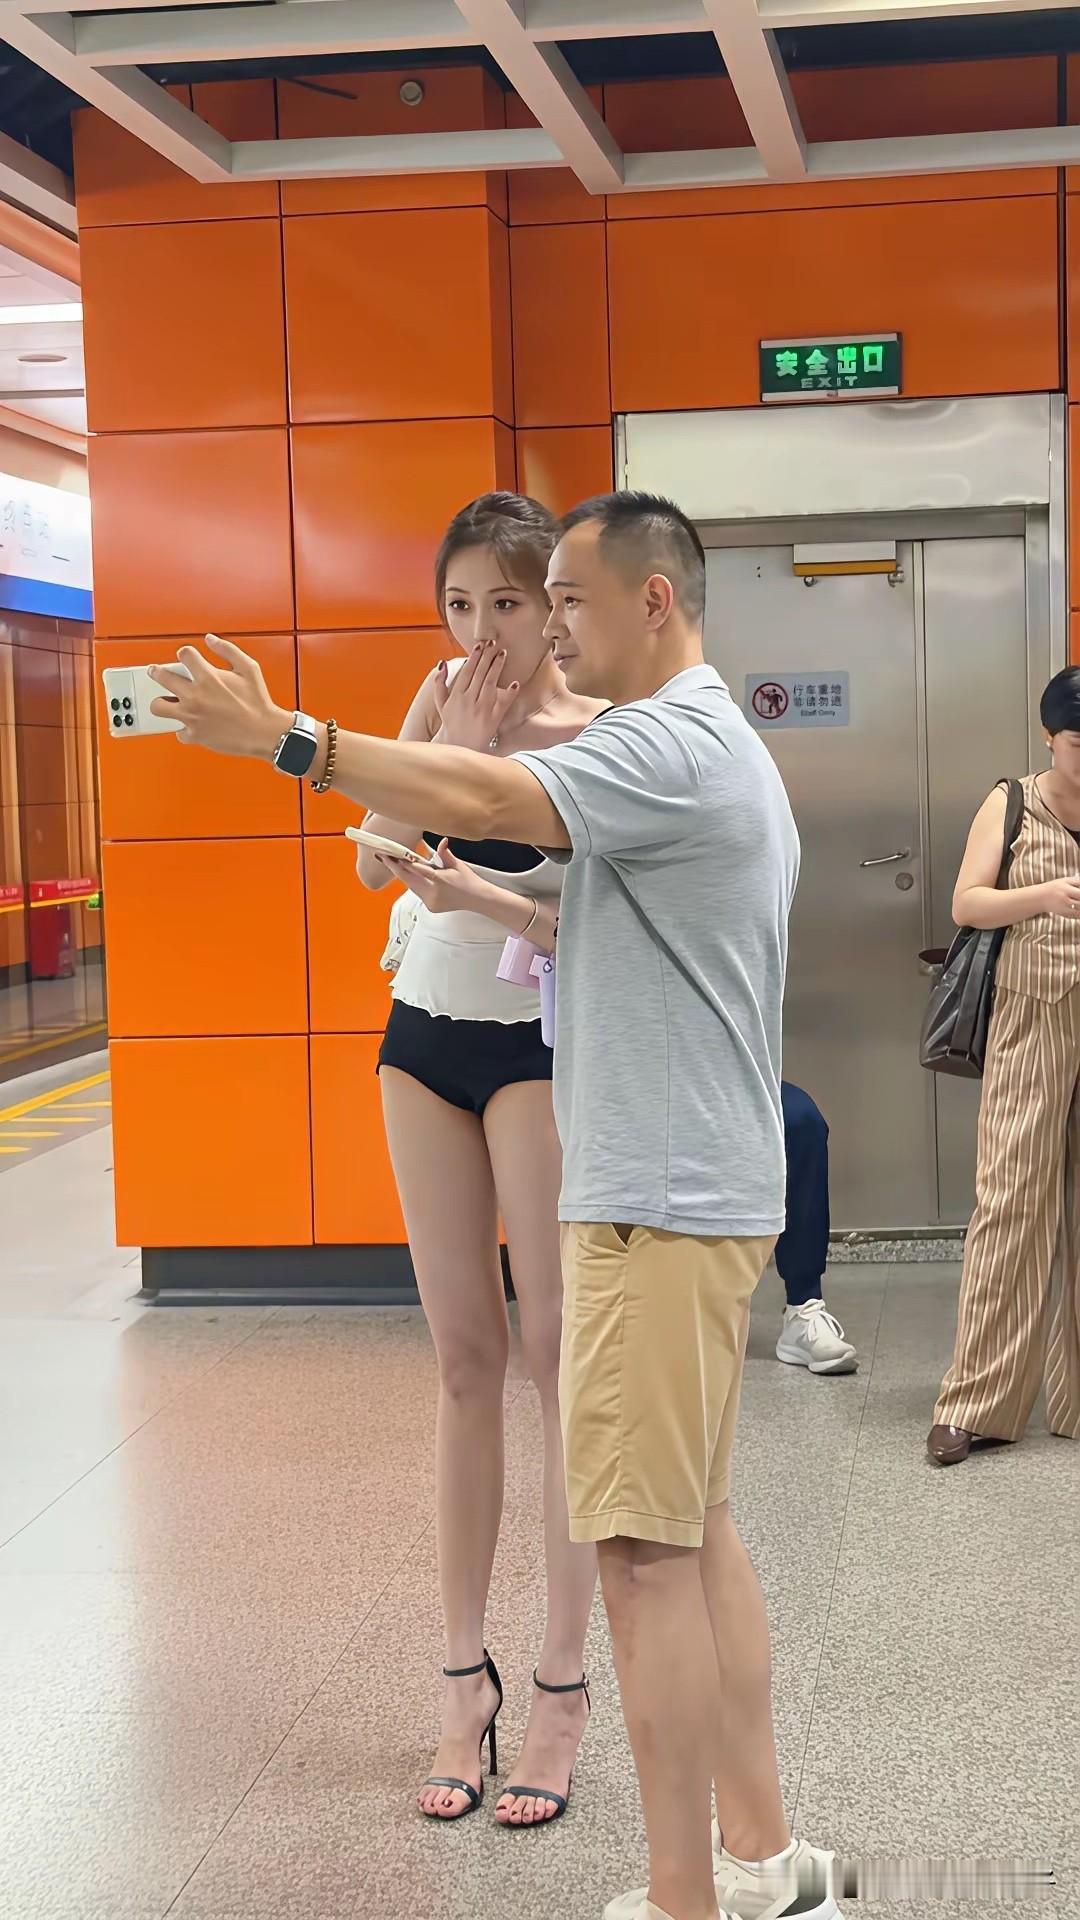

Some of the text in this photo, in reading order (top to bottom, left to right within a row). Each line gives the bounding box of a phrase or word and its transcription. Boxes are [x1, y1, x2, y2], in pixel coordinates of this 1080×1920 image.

[776, 345, 883, 377] 安全出口
[801, 376, 858, 388] EXIT
